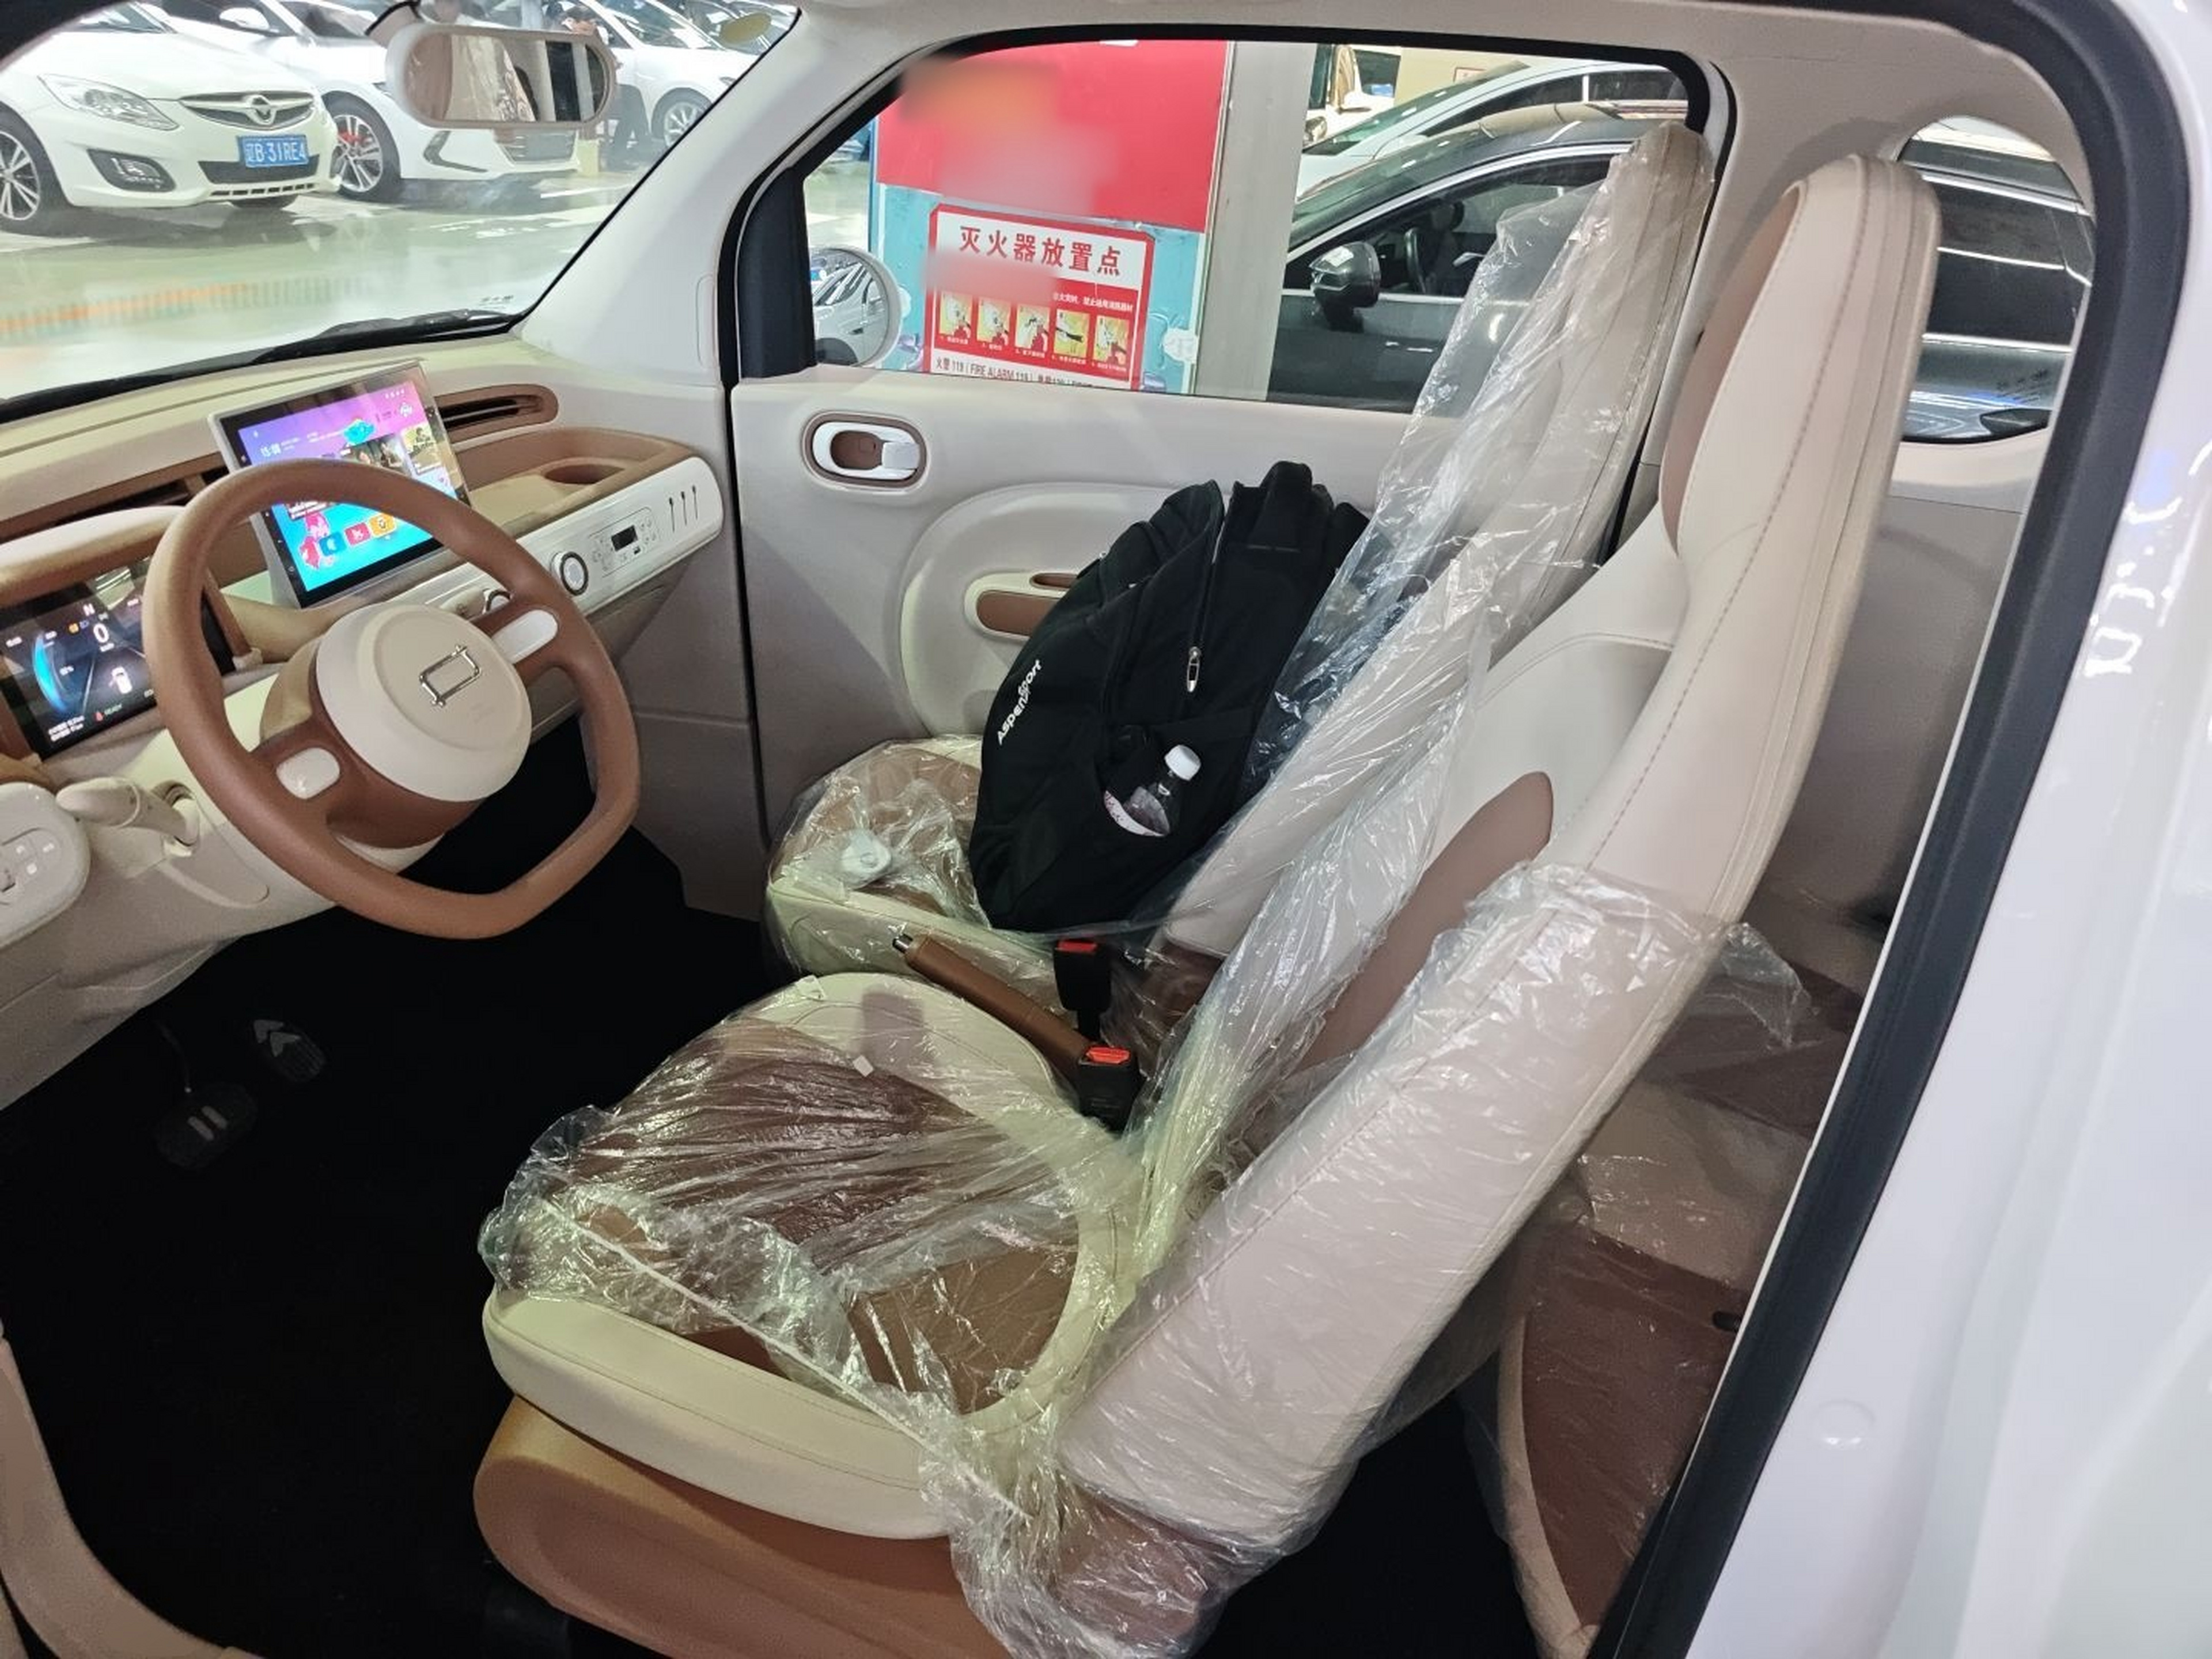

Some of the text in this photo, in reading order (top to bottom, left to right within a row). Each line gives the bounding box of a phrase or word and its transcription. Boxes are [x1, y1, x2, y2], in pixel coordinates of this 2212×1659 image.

[959, 226, 1120, 276] 灭火器放置点
